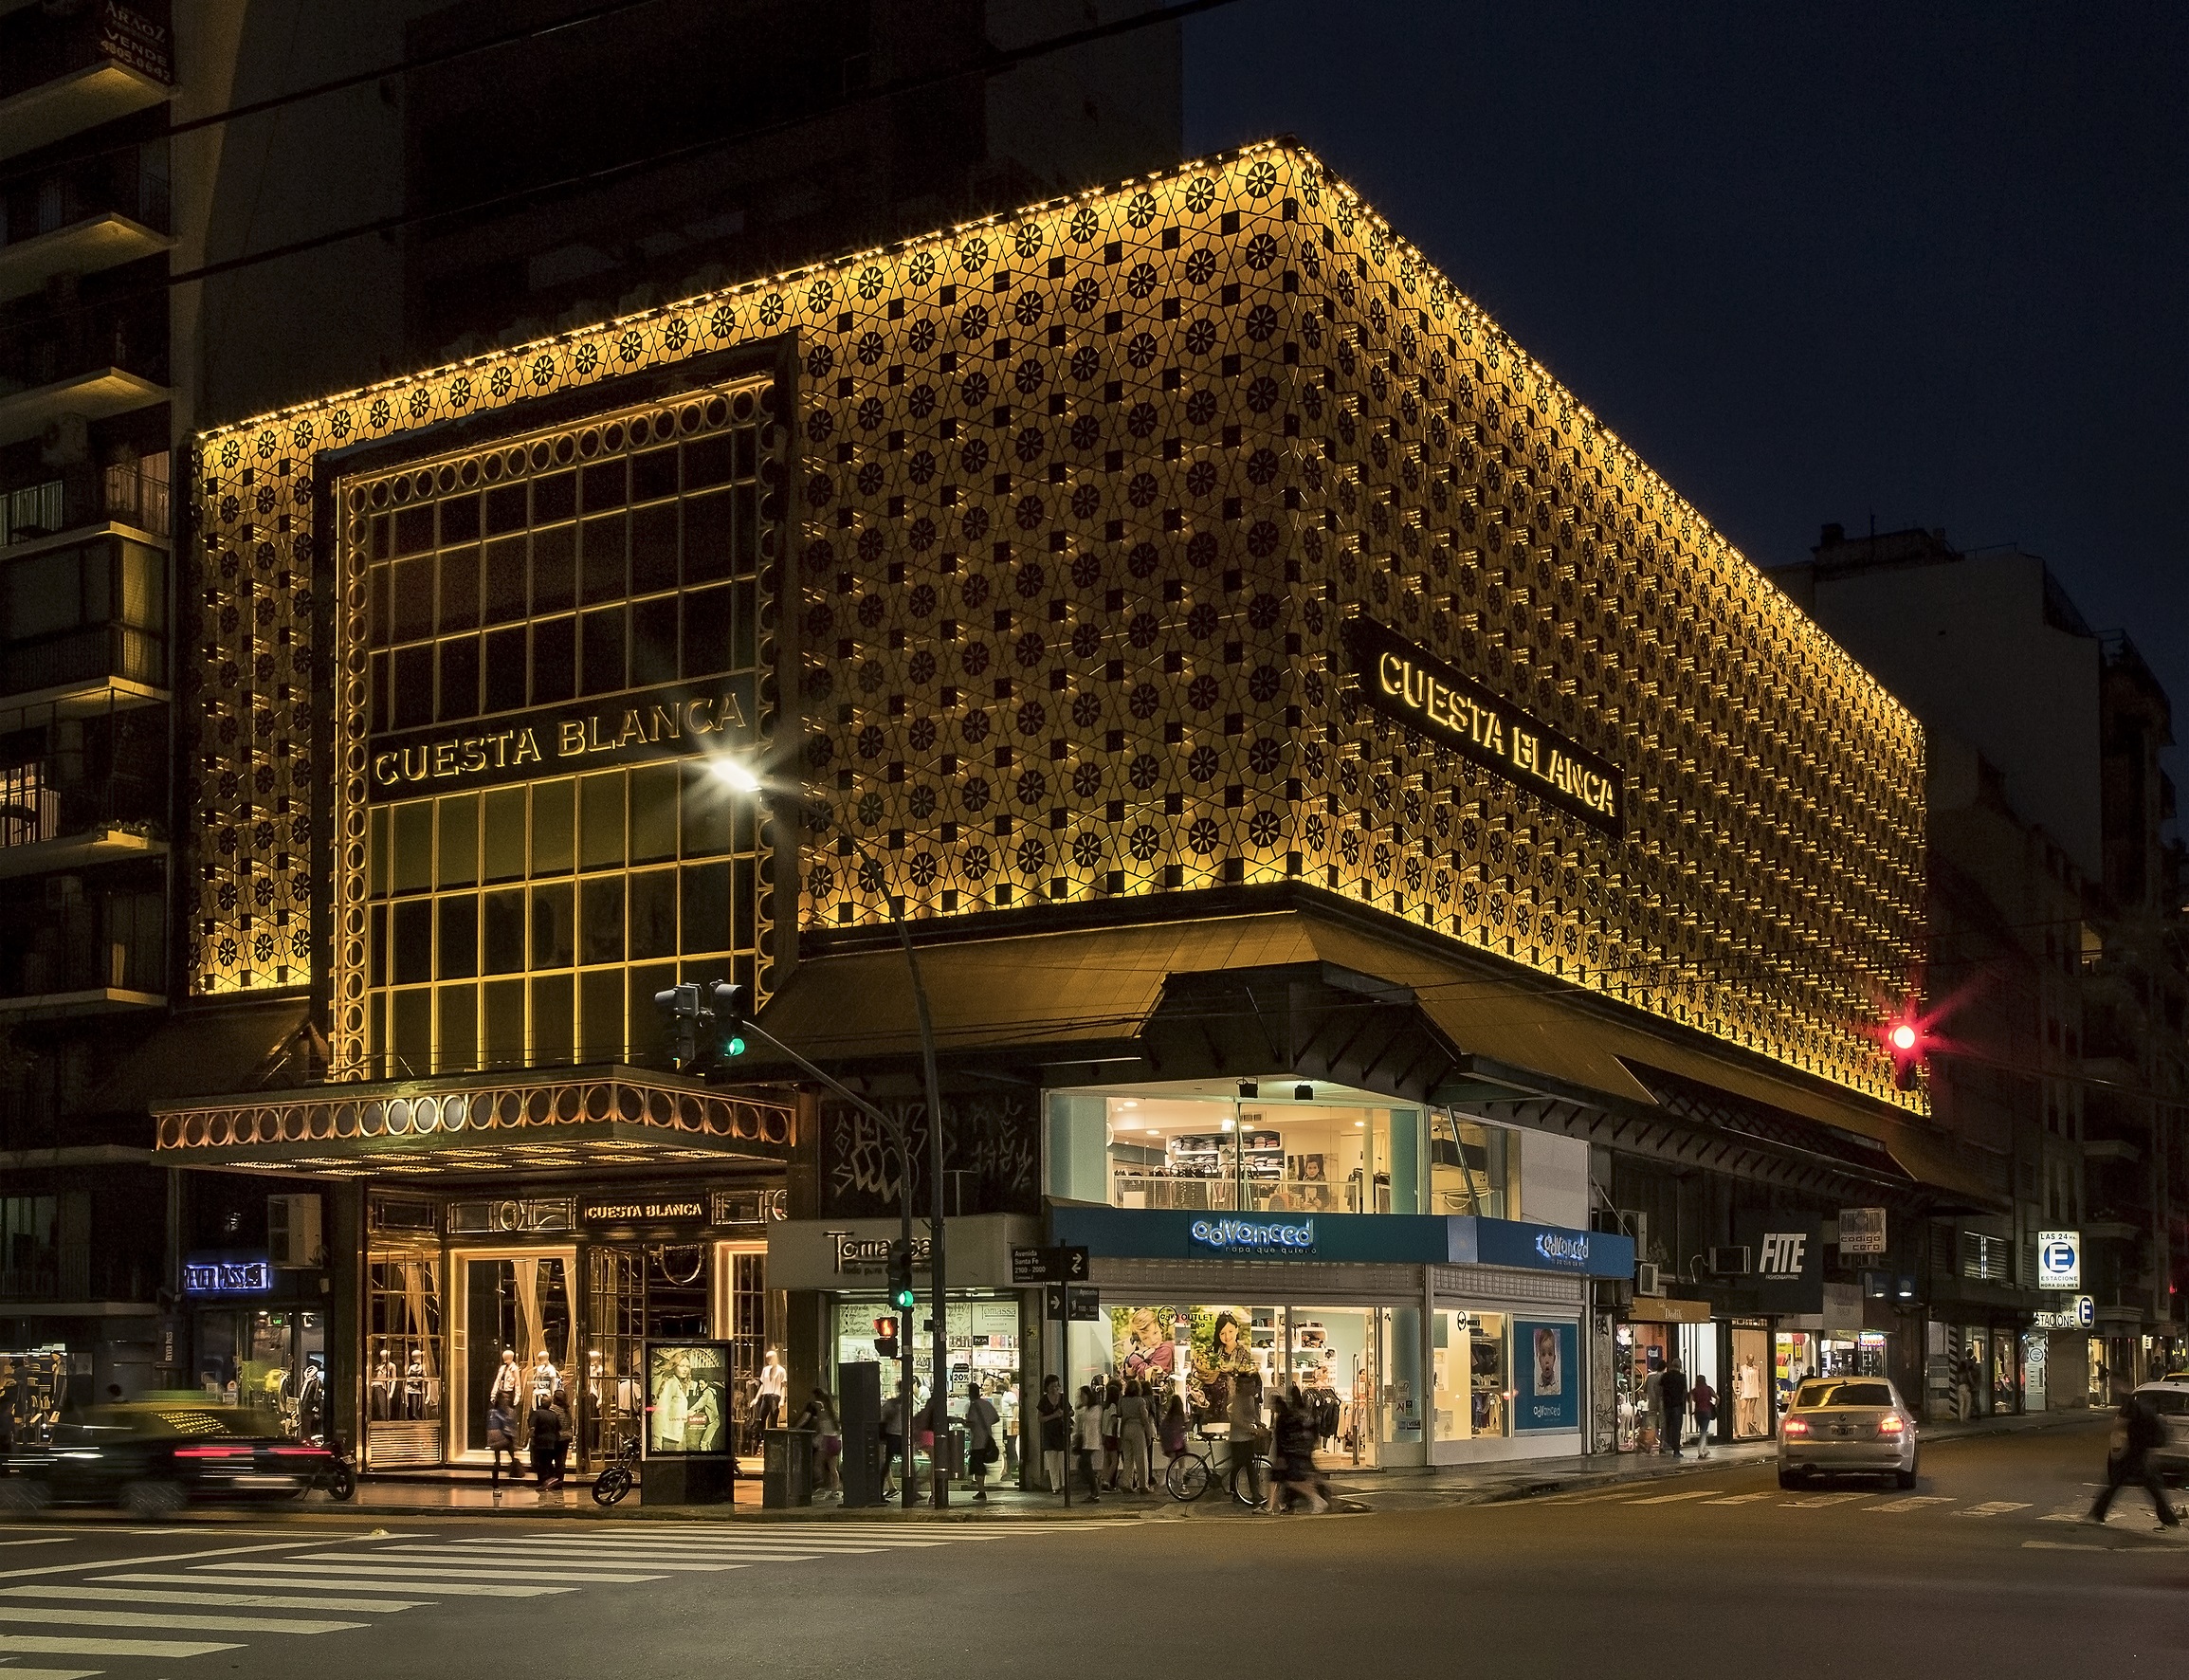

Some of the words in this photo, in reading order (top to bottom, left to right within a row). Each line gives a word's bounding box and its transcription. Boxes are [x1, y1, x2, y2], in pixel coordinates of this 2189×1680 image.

[103, 27, 168, 66] VENDE
[374, 727, 542, 787] CUESTA
[557, 692, 747, 757] BLANCA
[1379, 651, 1505, 756] CUESTA
[1513, 726, 1615, 817] BLANCA
[587, 1205, 643, 1219] CUESTA
[646, 1203, 702, 1217] BLANCA
[1193, 1218, 1314, 1246] advanced
[1014, 1250, 1038, 1258] Avenida
[1544, 1234, 1589, 1259] advanced
[1759, 1233, 1807, 1273] FITE
[2049, 1244, 2070, 1271] E
[977, 1304, 1016, 1320] Tomassa
[2081, 1300, 2091, 1324] E
